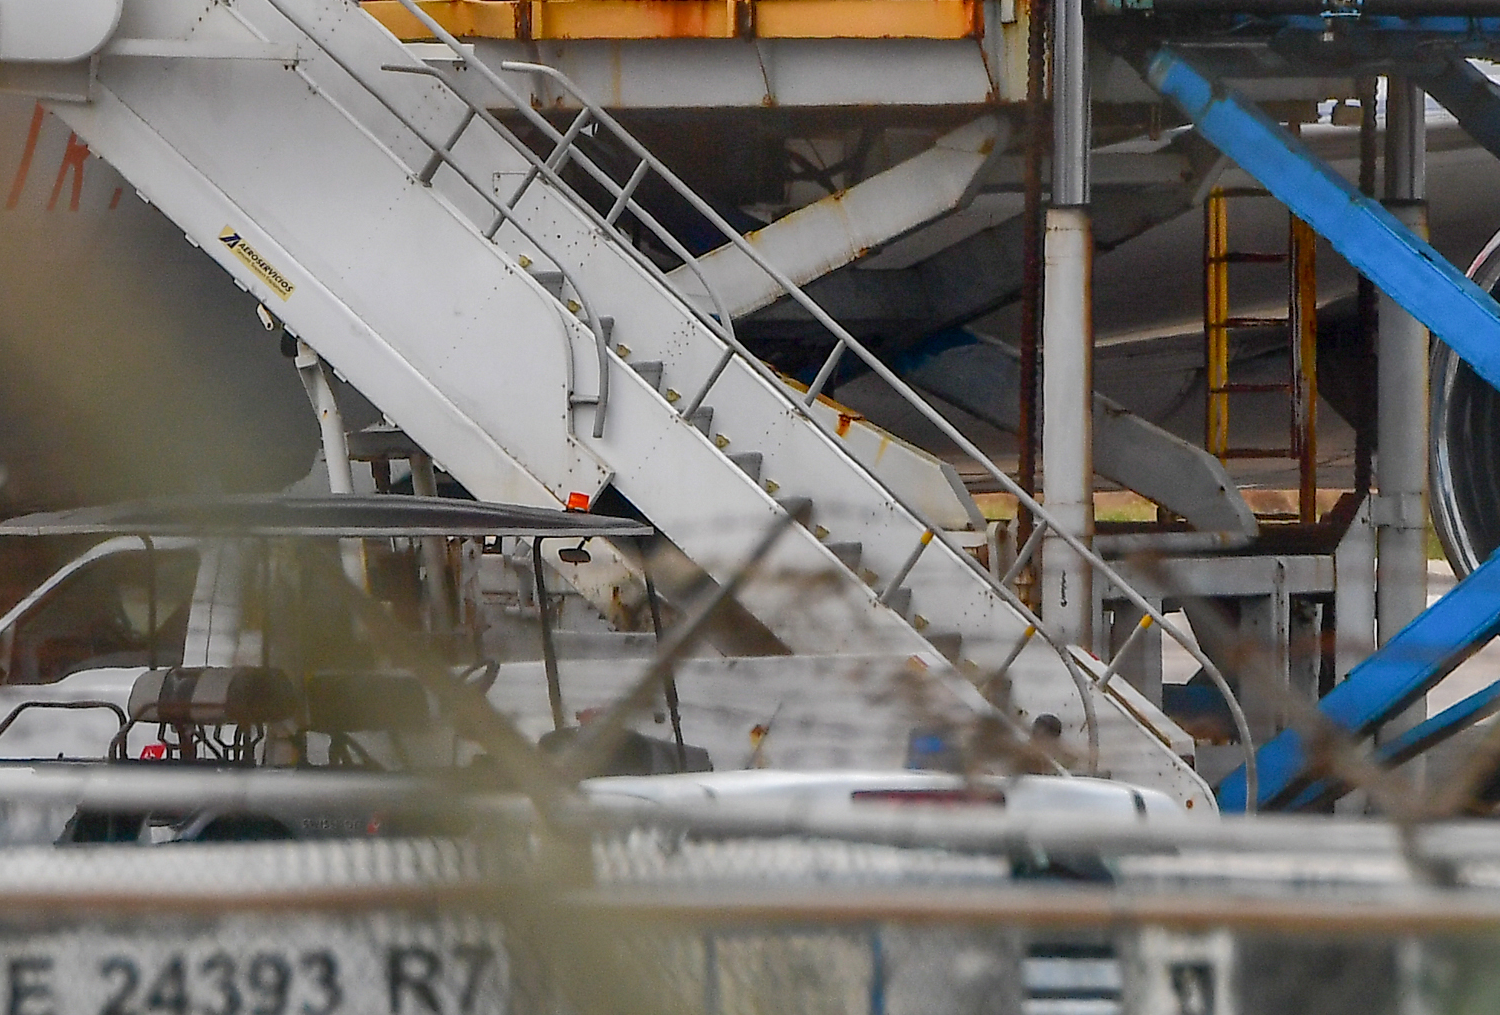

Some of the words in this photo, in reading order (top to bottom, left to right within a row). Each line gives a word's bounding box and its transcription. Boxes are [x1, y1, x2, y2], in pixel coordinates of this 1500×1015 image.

[238, 243, 293, 292] AEROSERVICIOS
[99, 950, 344, 1015] 24393
[388, 943, 496, 1015] R7
